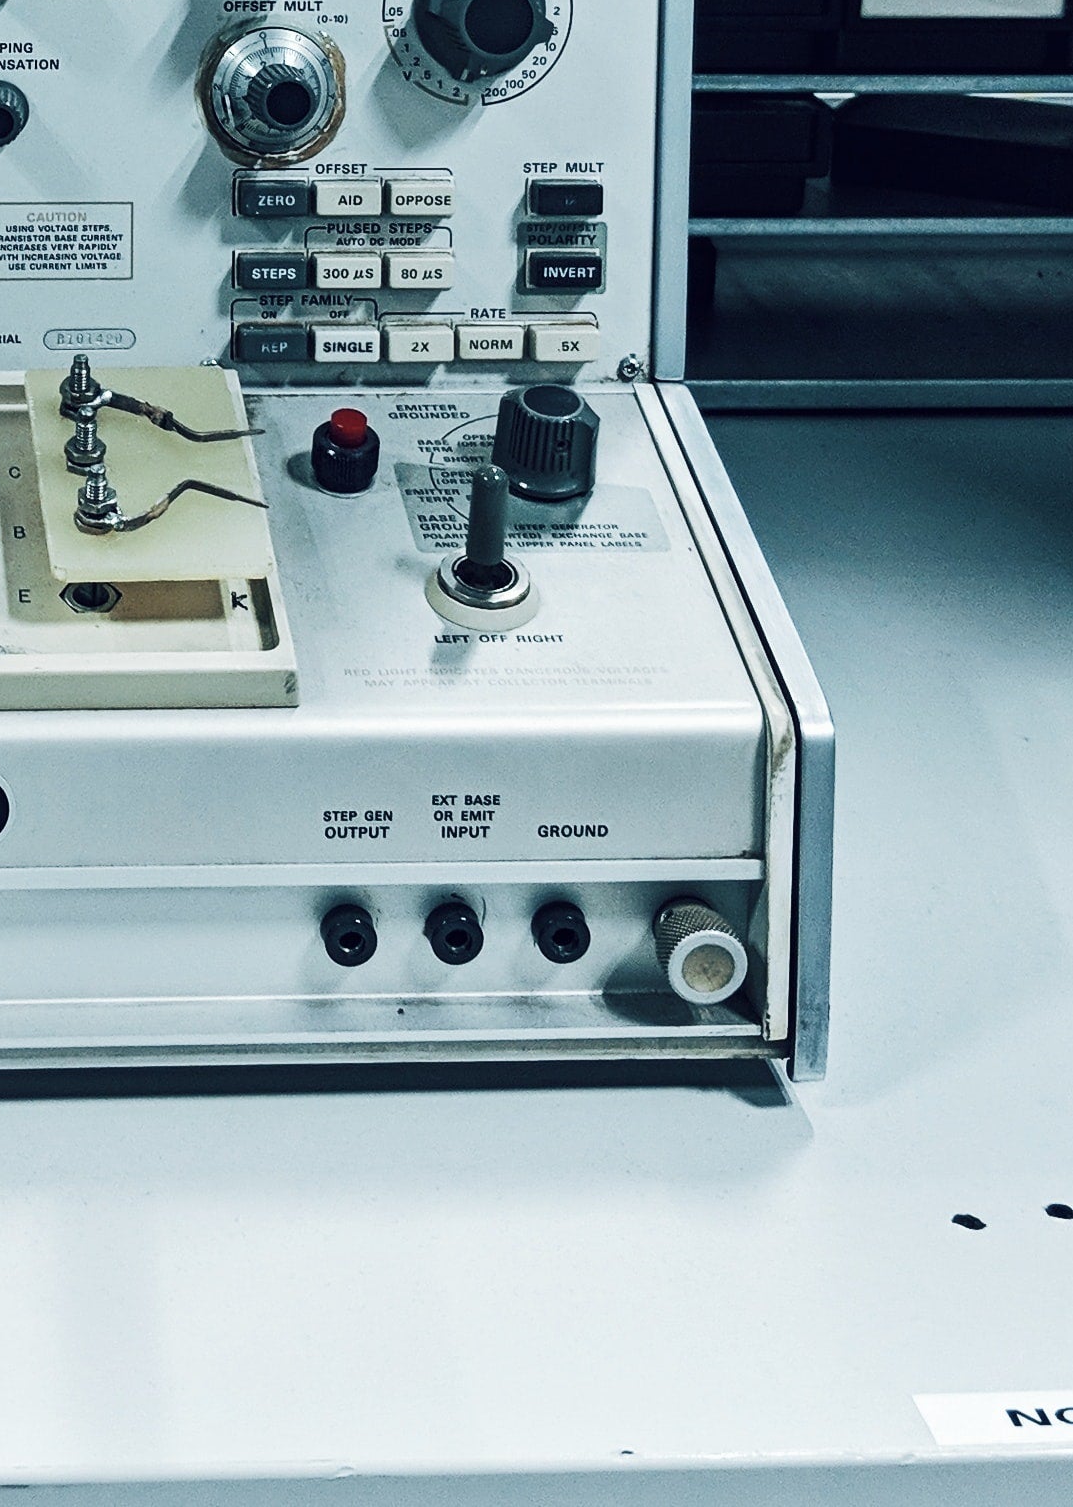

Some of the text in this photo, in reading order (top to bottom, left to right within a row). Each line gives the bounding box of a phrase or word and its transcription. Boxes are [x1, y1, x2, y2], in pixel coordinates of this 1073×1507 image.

[224, 1, 323, 11] OFFSET MULT
[315, 164, 368, 174] OFFSET
[523, 162, 604, 173] STEP MULT
[259, 195, 295, 206] ZERO
[338, 195, 363, 206] AID
[395, 195, 451, 206] OPPOSE
[328, 223, 432, 234] PULSED STEPS
[337, 237, 421, 246] AUTO DC MODE
[252, 268, 296, 279] STEPS
[323, 268, 349, 279] 300
[401, 268, 419, 279] 80
[544, 267, 595, 278] INVERT
[260, 294, 353, 305] STEP FAMILY
[471, 308, 506, 318] RATE
[323, 341, 373, 353] SINGLE
[411, 341, 429, 352] 2X
[469, 339, 512, 350] NORM
[558, 340, 580, 352] .5X
[14, 527, 25, 539] B
[19, 590, 31, 602] E
[435, 635, 469, 643] LEFT
[432, 795, 500, 806] EXT BASE
[323, 811, 393, 821] STEP GEN
[434, 811, 495, 821] OR EMIT
[325, 826, 389, 838] OUTPUT
[441, 826, 490, 838] INPUT
[538, 825, 609, 837] GROUND
